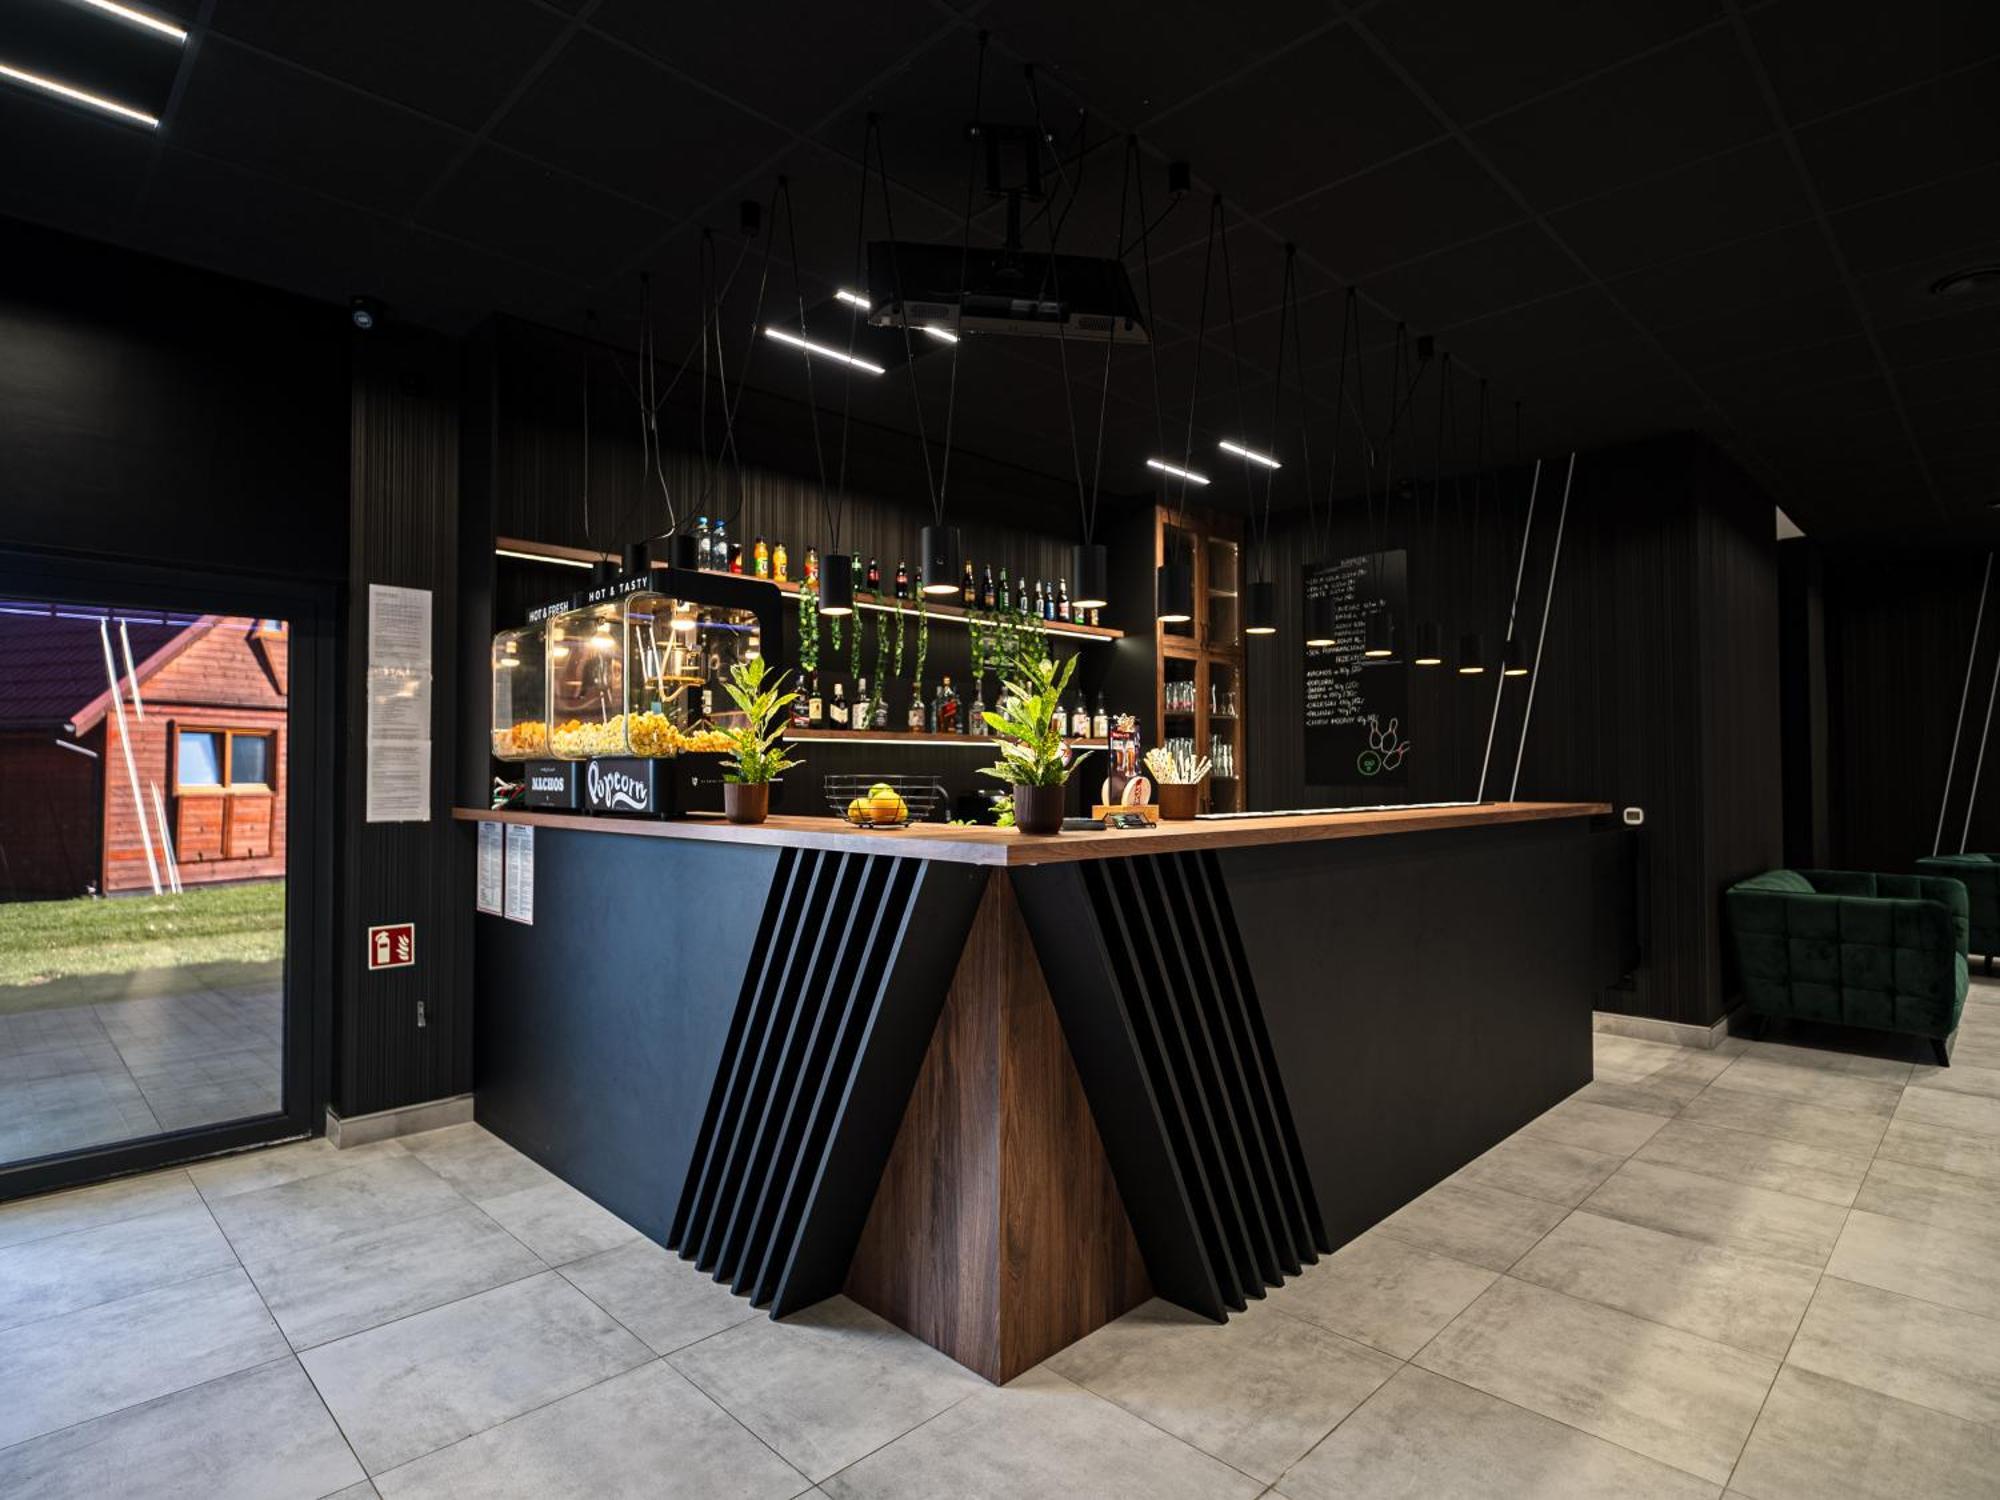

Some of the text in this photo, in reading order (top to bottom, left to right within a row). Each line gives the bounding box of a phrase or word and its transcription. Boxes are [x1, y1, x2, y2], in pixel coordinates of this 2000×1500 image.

[588, 577, 648, 602] HOT & TASTY
[529, 609, 542, 622] HOT
[548, 601, 569, 616] FRESH
[531, 776, 565, 792] NACHOS
[588, 760, 648, 809] Popcorn
